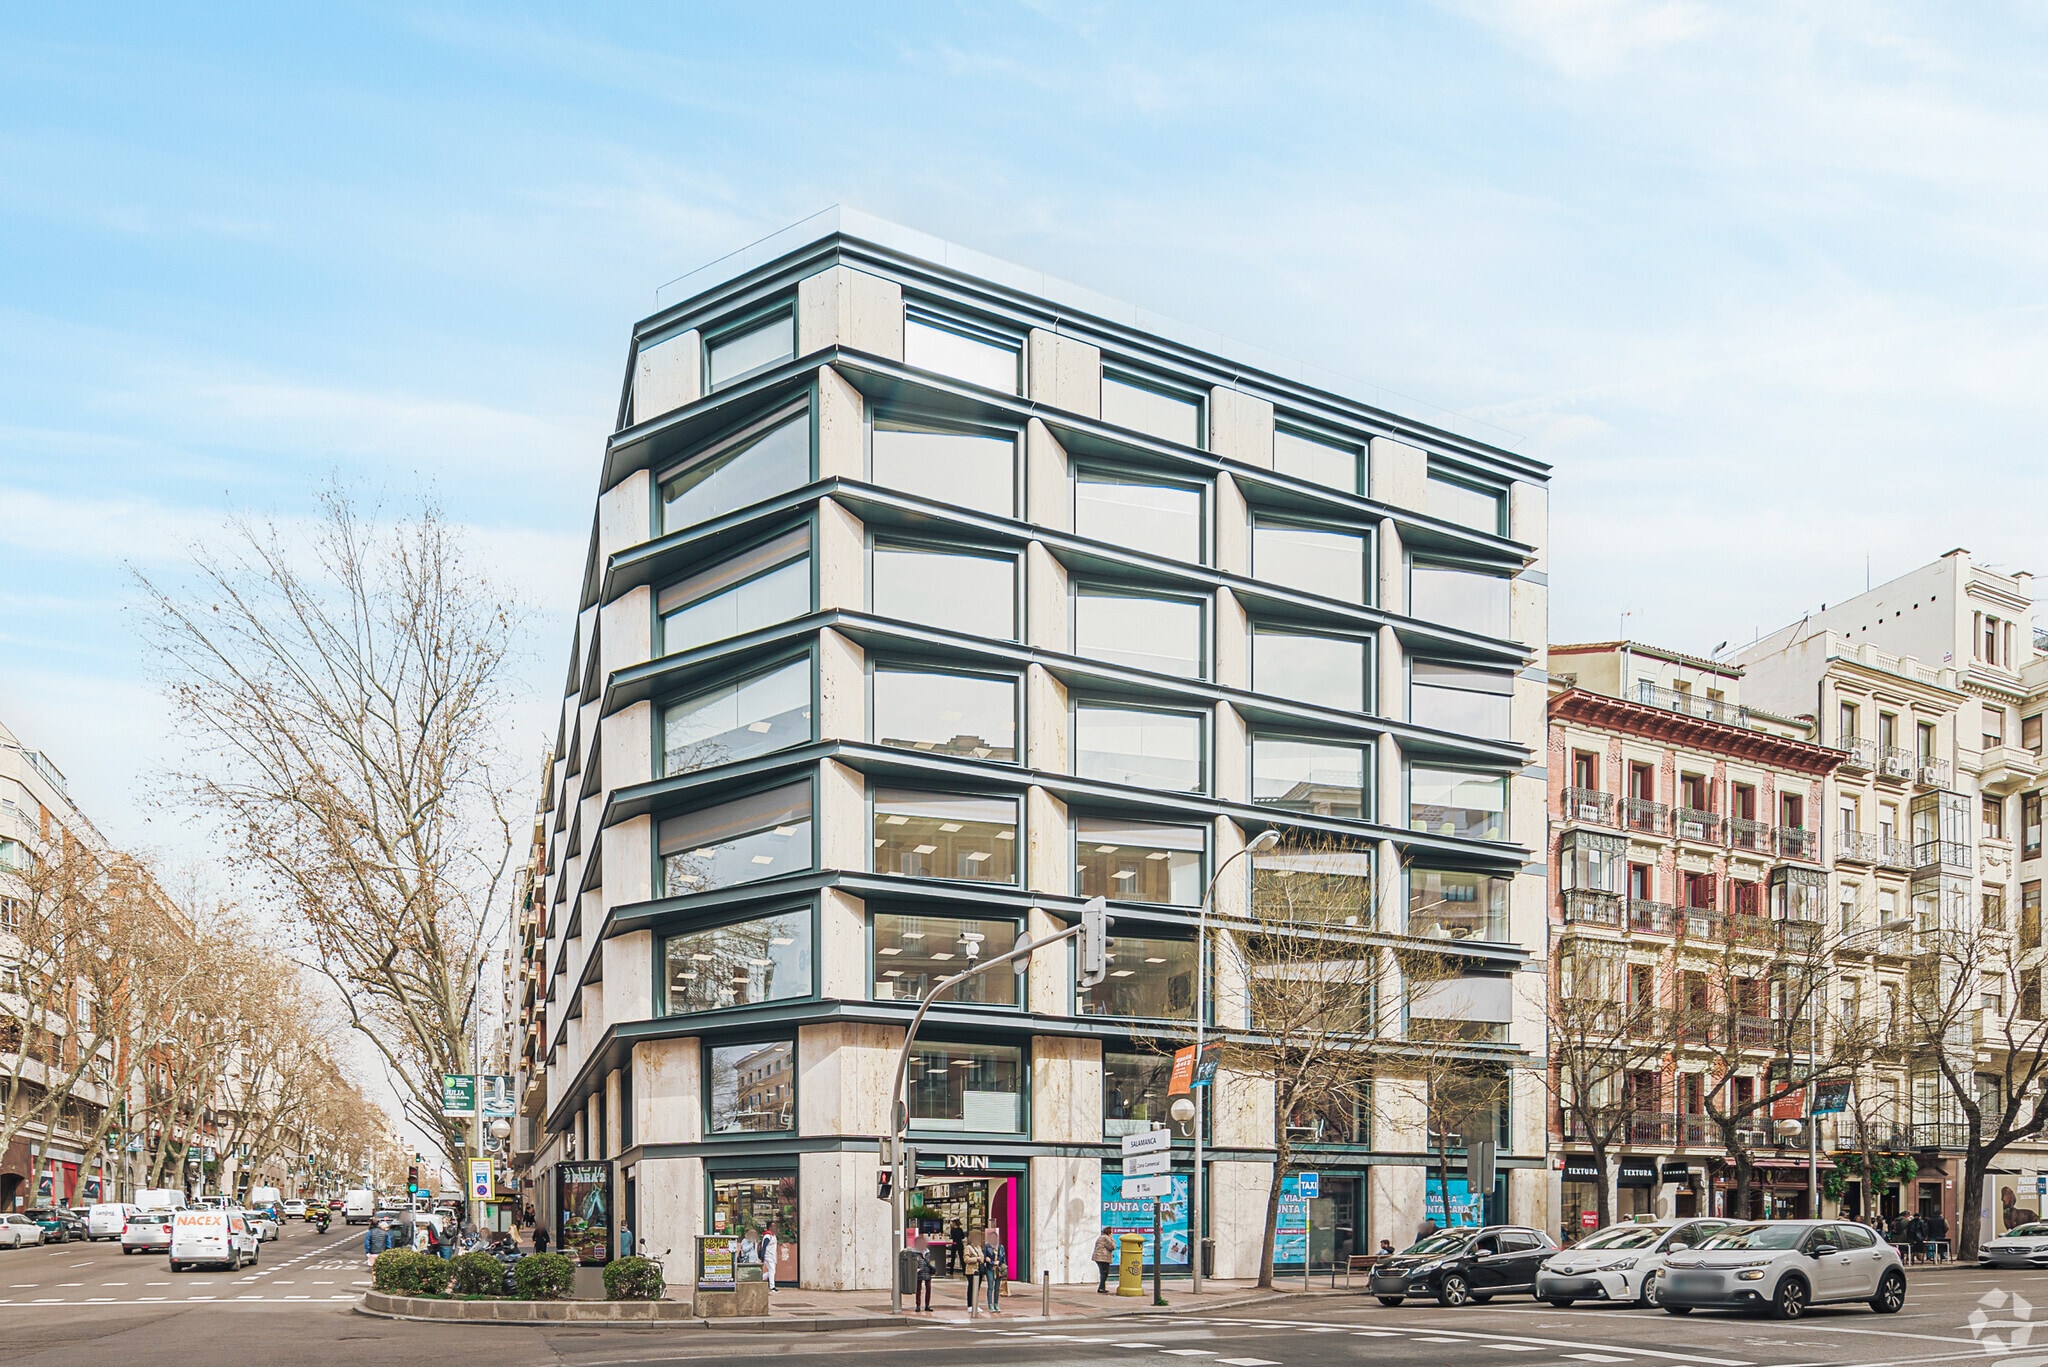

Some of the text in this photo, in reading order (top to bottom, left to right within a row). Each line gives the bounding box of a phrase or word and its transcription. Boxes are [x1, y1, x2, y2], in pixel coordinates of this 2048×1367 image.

[1130, 1137, 1157, 1148] SALAMANCA
[946, 1155, 990, 1168] DRUNI
[1568, 1167, 1598, 1175] TEXTURA
[564, 1172, 606, 1183] 2 PARA 2
[1301, 1182, 1317, 1190] TAXI
[1103, 1202, 1139, 1212] PUNTA
[176, 1215, 222, 1226] NACEX
